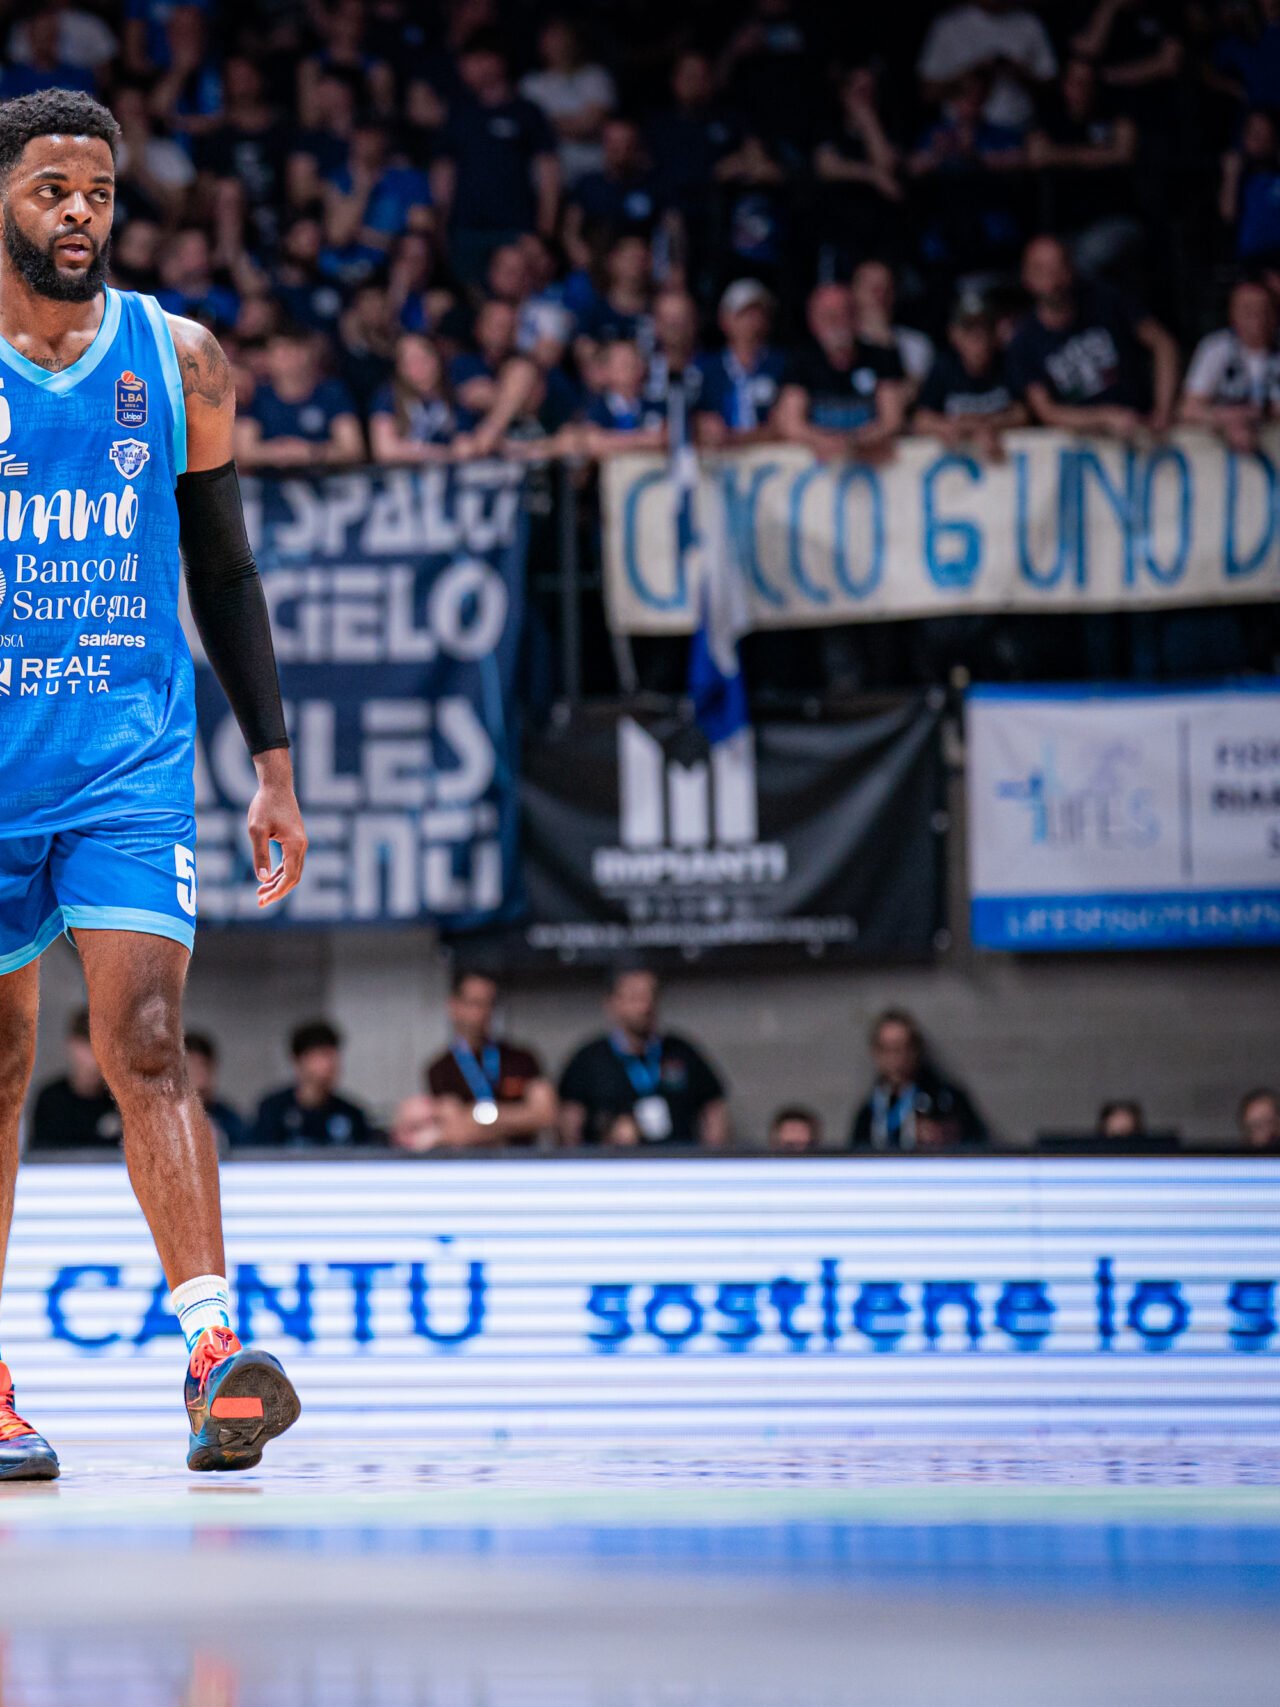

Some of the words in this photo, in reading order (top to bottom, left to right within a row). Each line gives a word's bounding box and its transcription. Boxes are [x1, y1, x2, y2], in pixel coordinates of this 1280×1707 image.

[120, 393, 144, 402] LBA
[123, 412, 143, 422] Unipol
[1016, 446, 1194, 591] UNO
[14, 554, 116, 584] Banco
[120, 552, 139, 582] di
[21, 655, 111, 679] REALE
[174, 843, 196, 917] 5
[47, 1234, 488, 1347] CANTÙ
[1095, 1256, 1192, 1352] lo
